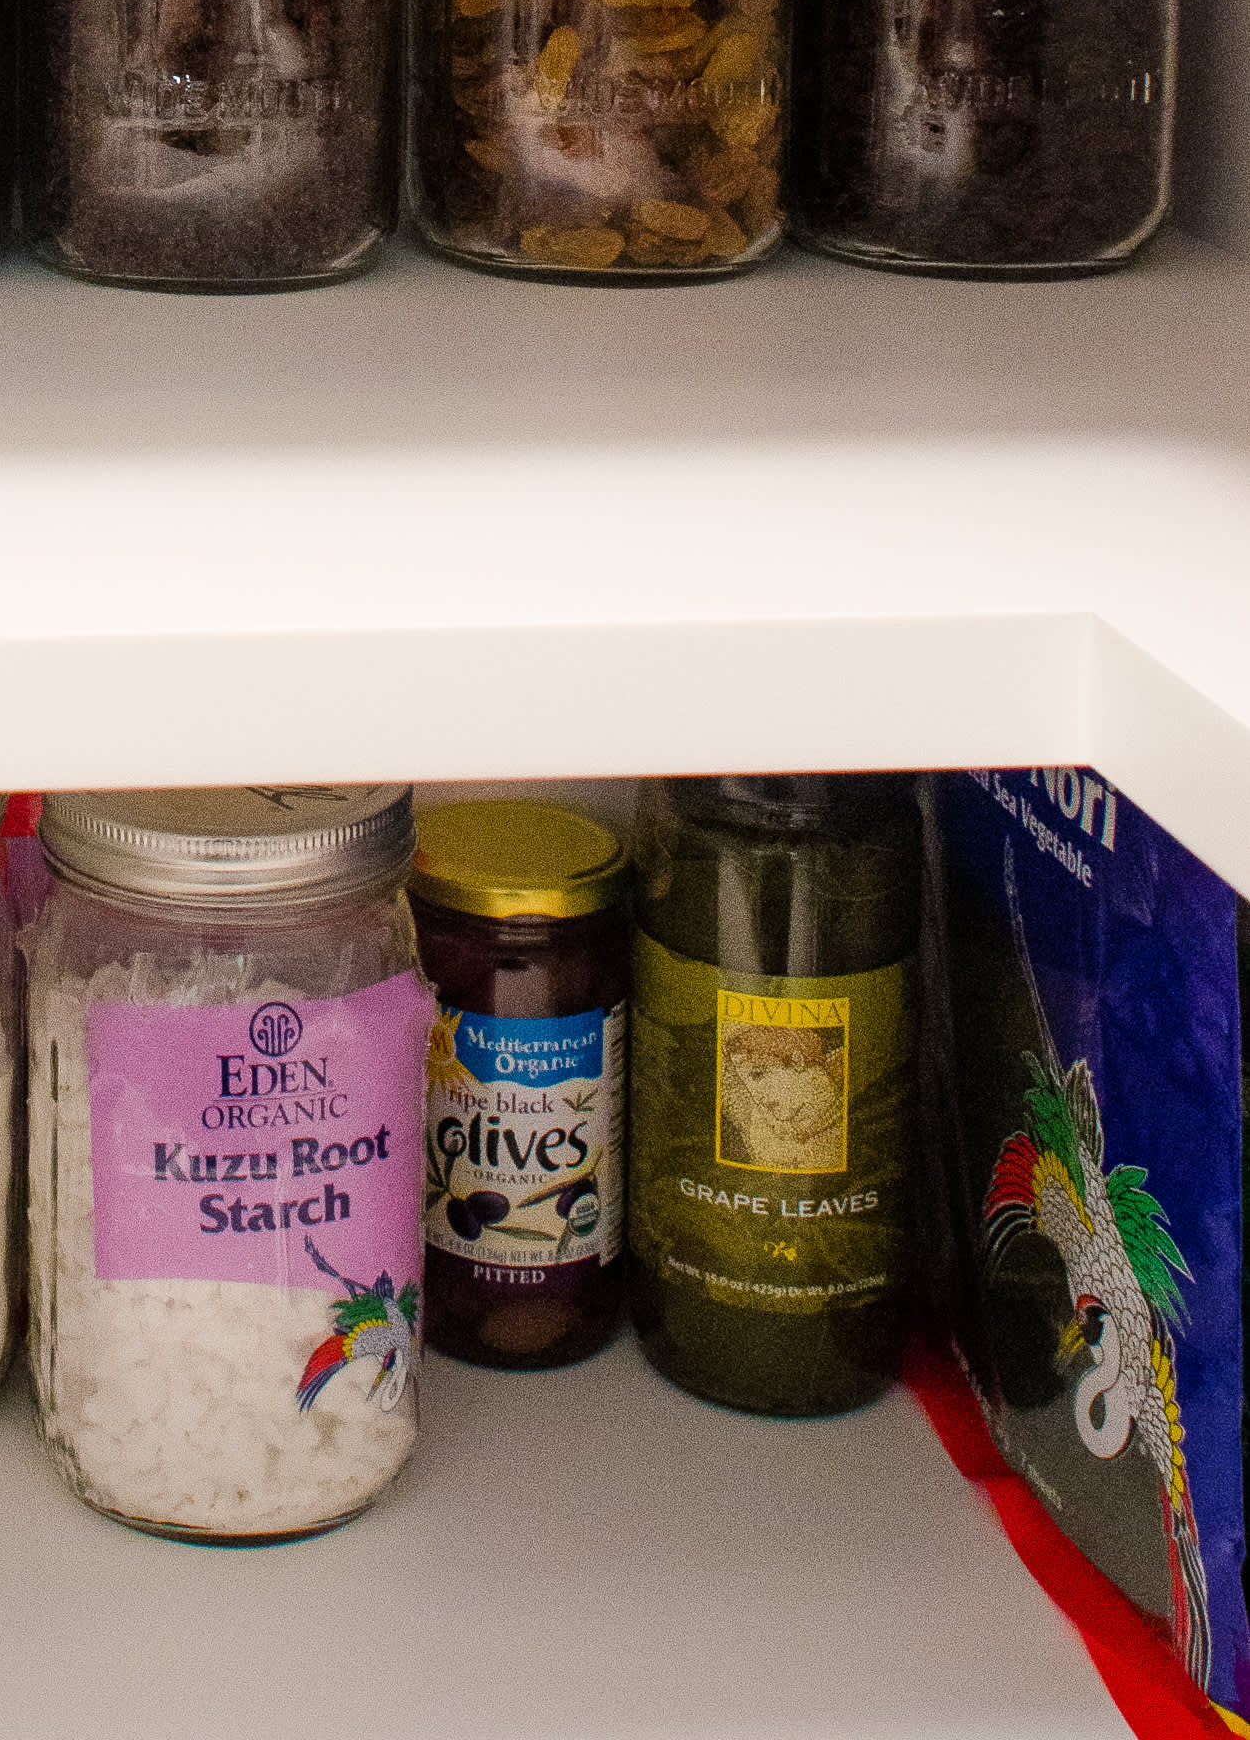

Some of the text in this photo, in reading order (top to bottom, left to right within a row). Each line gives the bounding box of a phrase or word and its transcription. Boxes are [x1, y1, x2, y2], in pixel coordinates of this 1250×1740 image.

[992, 771, 1093, 888] Sea Vegetable
[722, 994, 844, 1025] DIVINA
[465, 1025, 597, 1054] Mediterranean
[217, 1054, 328, 1098] EDEN
[495, 1052, 580, 1080] Organic
[201, 1093, 348, 1130] ORGANIC
[449, 1086, 555, 1115] ripe black
[152, 1125, 391, 1183] Kuzu Root
[473, 1170, 547, 1185] ORGANIC
[199, 1184, 351, 1235] Starch
[679, 1176, 879, 1219] GRAPE LEAVES
[473, 1264, 546, 1284] PITTED
